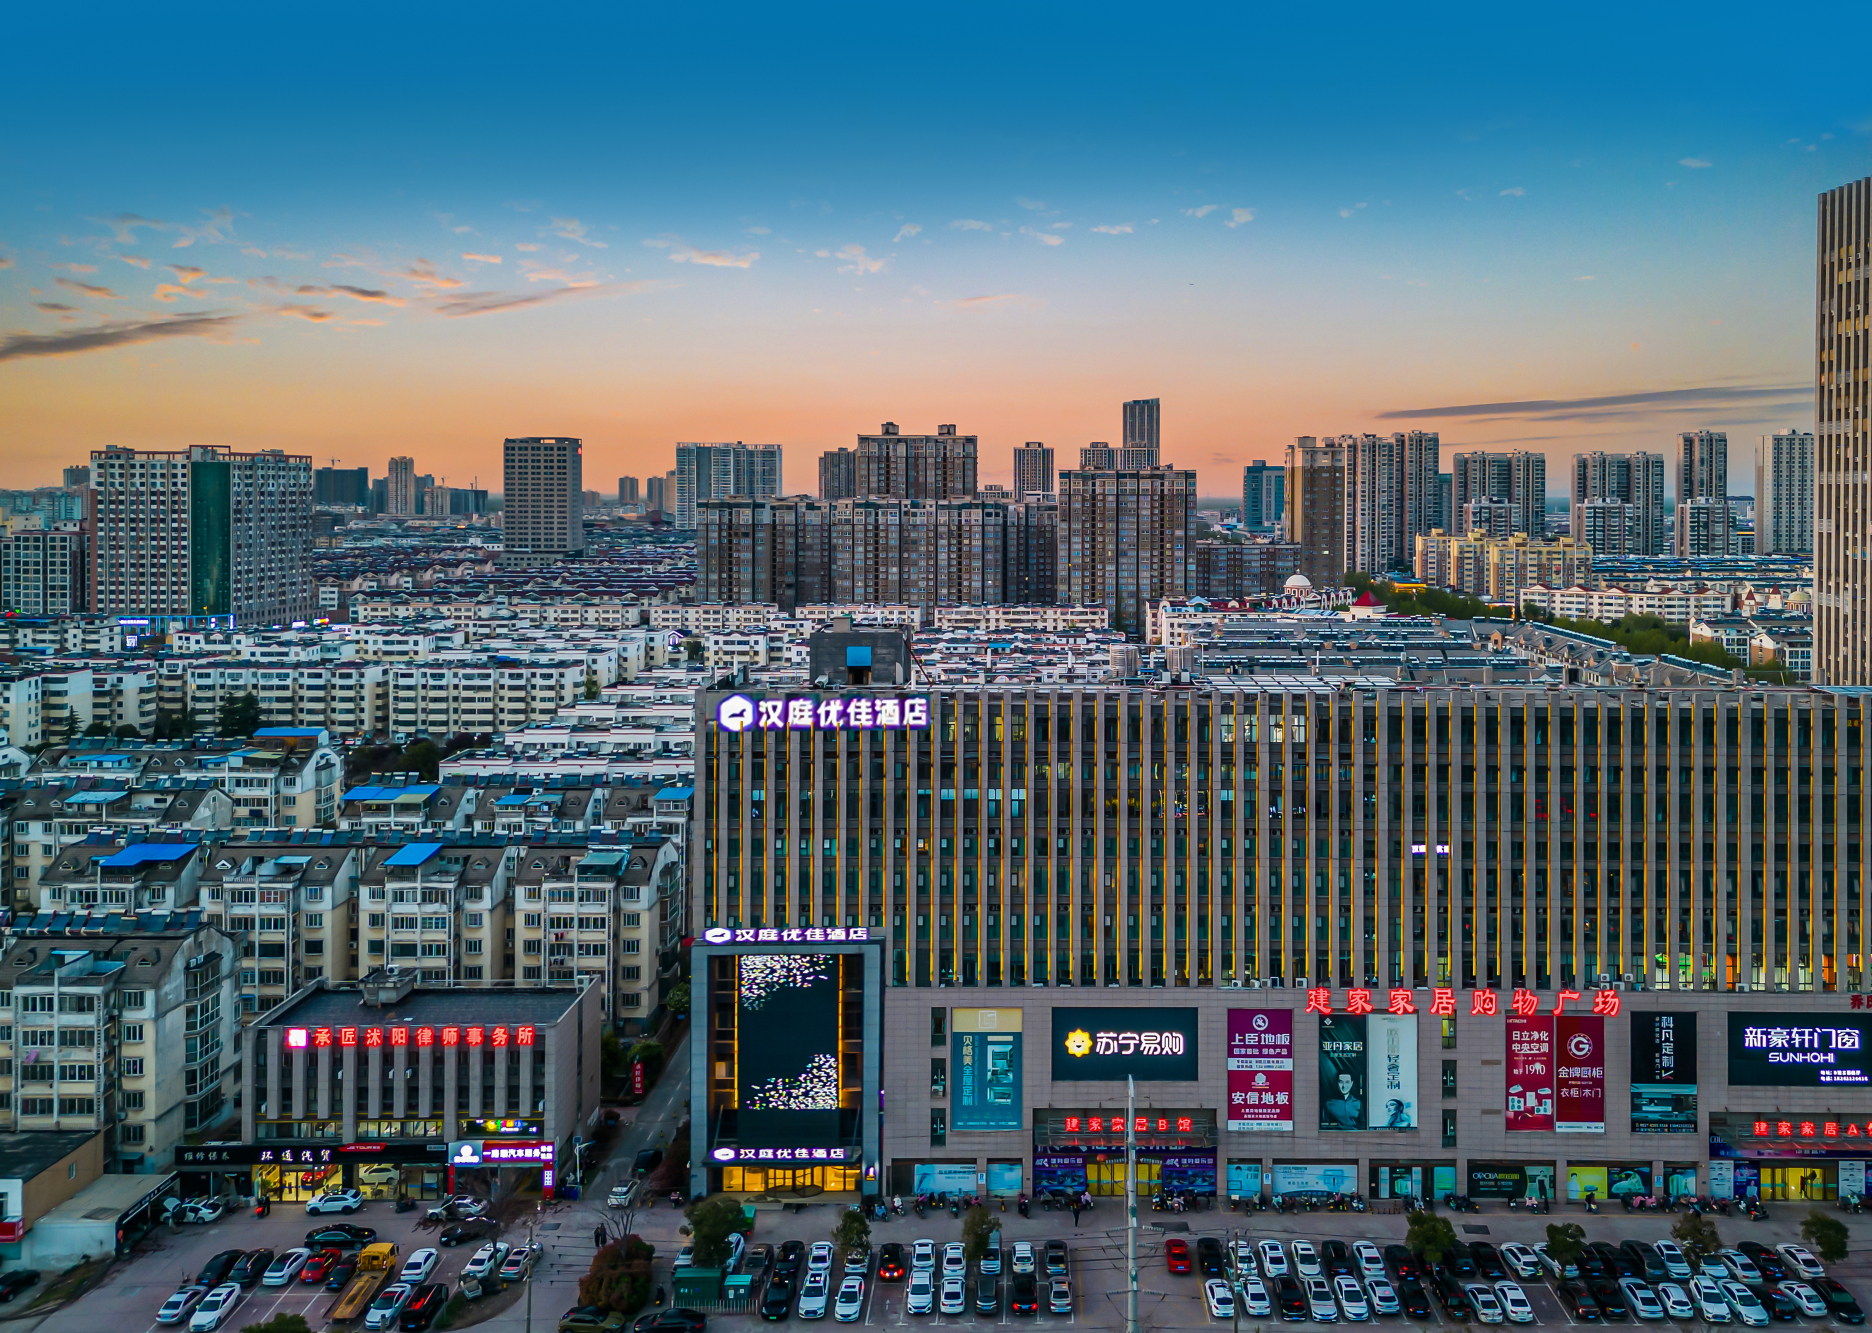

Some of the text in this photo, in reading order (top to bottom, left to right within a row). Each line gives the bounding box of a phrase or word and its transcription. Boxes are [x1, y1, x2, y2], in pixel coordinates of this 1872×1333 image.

[758, 698, 928, 728] 汉庭优佳酒店
[735, 927, 868, 942] 汉庭优佳酒店
[1305, 989, 1620, 1016] 建家家居购物广场
[315, 1028, 534, 1046] 承匠沭阳律师事务所
[1231, 1033, 1290, 1045] 上臣地板
[1512, 1031, 1549, 1041] 日立净化
[1661, 1016, 1674, 1068] 科凡定制
[1744, 1027, 1860, 1049] 新豪轩门窗
[1096, 1032, 1184, 1055] 苏宁易购
[1322, 1041, 1363, 1051] 亚丹家居
[1511, 1043, 1549, 1053] 中央空调
[1768, 1052, 1835, 1063] SUNHOHI
[962, 1035, 973, 1106] 贝格美全屋定制
[1558, 1066, 1604, 1079] 金牌厨柜
[1231, 1092, 1289, 1105] 安信地板
[1065, 1118, 1192, 1132] 建家家居B馆
[739, 1149, 845, 1159] 汉庭优佳酒店
